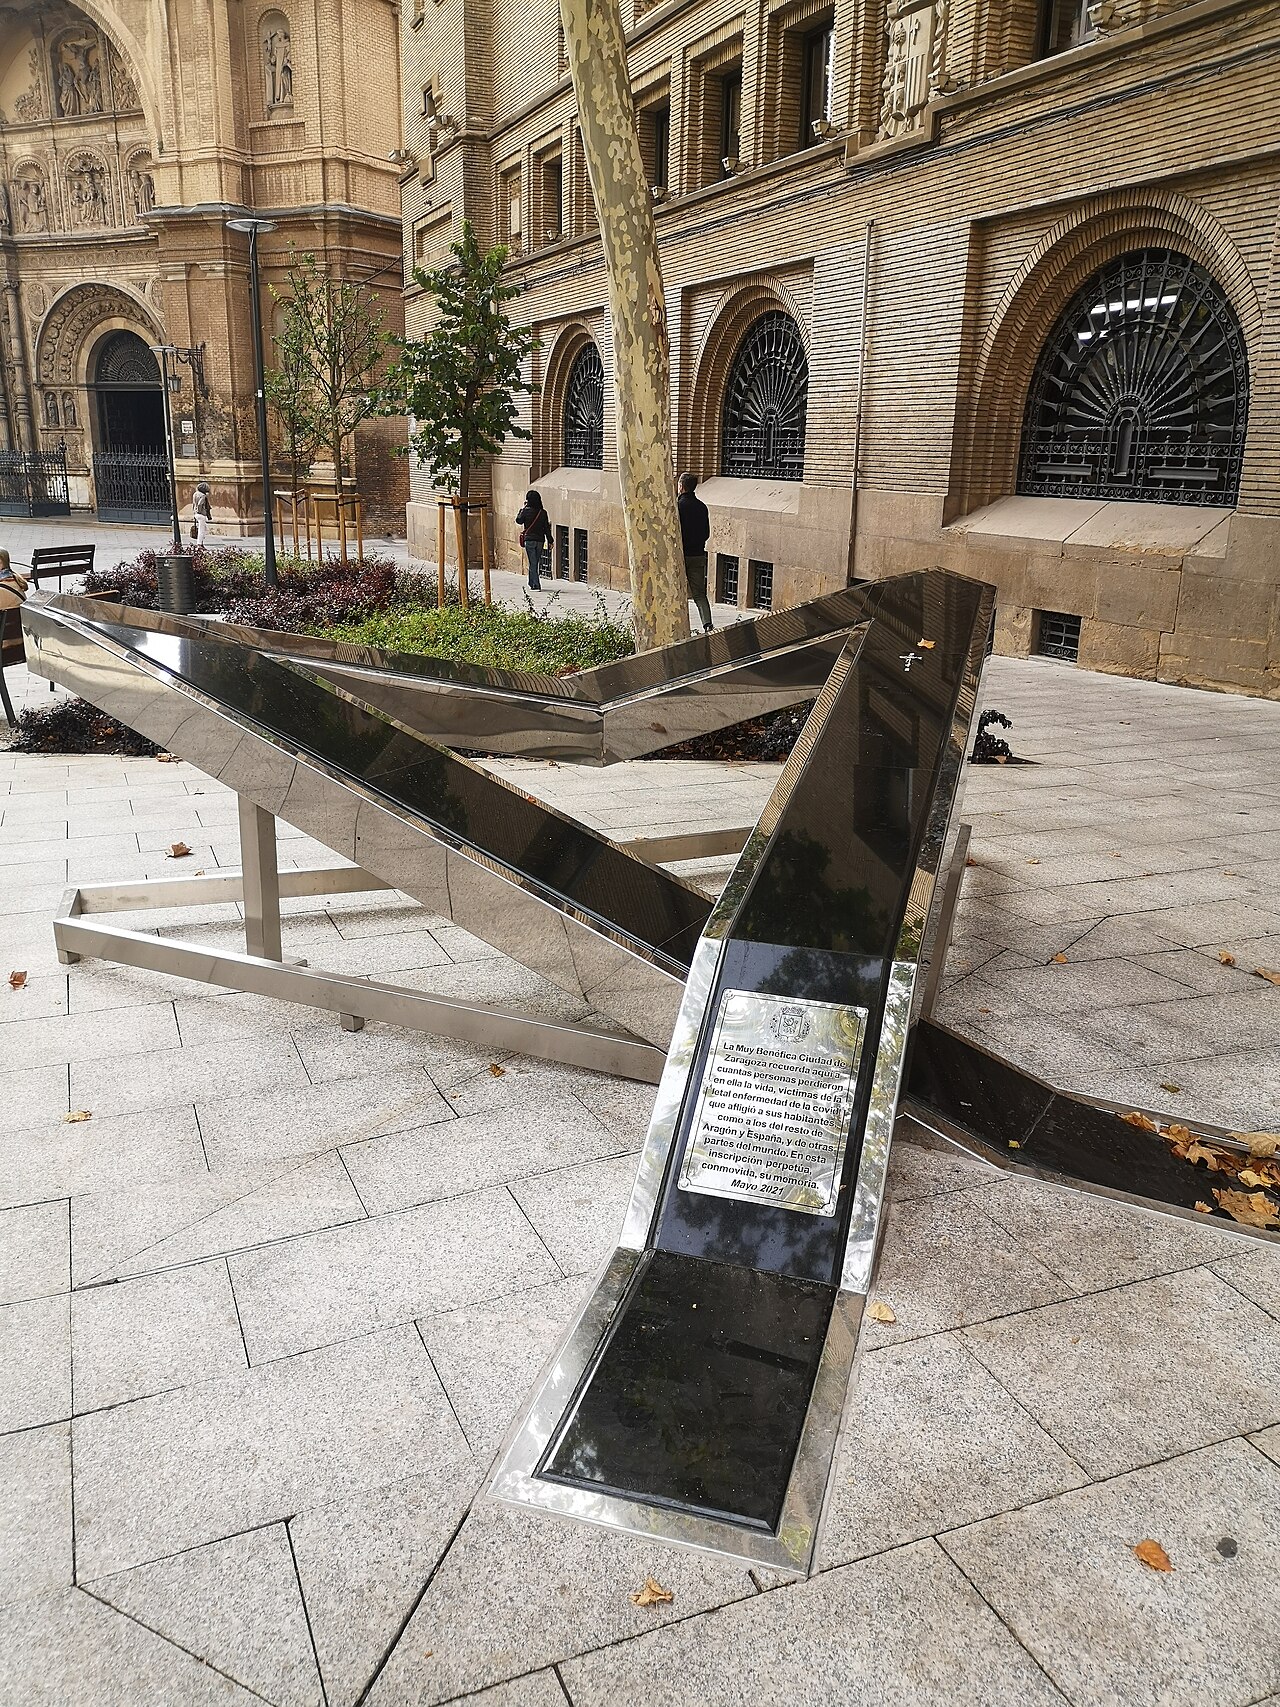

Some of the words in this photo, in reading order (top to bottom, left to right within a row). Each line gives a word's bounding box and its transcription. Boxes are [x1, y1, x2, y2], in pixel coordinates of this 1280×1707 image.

[724, 1042, 734, 1050] La
[736, 1044, 754, 1055] Muy
[756, 1047, 797, 1060] Benéfica
[798, 1054, 832, 1066] Ciudad
[834, 1060, 846, 1068] de
[724, 1054, 766, 1067] Zaragoza
[768, 1062, 810, 1074] recuerda
[716, 1066, 752, 1076] cuantas
[753, 1072, 796, 1084] personas
[798, 1078, 844, 1091] perdieron
[726, 1078, 742, 1088] ella
[744, 1080, 752, 1088] la
[754, 1082, 776, 1094] vida,
[820, 1094, 832, 1102] de
[834, 1095, 842, 1103] la
[708, 1100, 726, 1108] que
[728, 1102, 756, 1114] afligió
[765, 1110, 782, 1118] sus
[711, 1088, 732, 1098] letal
[732, 1092, 788, 1106] enfermedad
[789, 1100, 801, 1108] de
[802, 1102, 810, 1110] la
[702, 1123, 737, 1136] Aragón
[738, 1130, 746, 1138] y
[786, 1138, 792, 1146] y
[794, 1138, 806, 1148] de
[808, 1142, 834, 1152] otras
[717, 1114, 744, 1124] como
[752, 1118, 767, 1128] los
[768, 1122, 784, 1130] del
[784, 1125, 810, 1135] resto
[811, 1128, 824, 1138] de
[704, 1137, 734, 1148] partes
[736, 1142, 752, 1150] del
[752, 1145, 788, 1158] mundo.
[790, 1150, 804, 1160] En
[805, 1154, 826, 1164] esta
[708, 1148, 762, 1166] inscripción
[702, 1162, 758, 1179] conmovida,
[760, 1172, 772, 1180] su
[772, 1174, 819, 1190] memoria.
[730, 1178, 758, 1190] Mayo
[760, 1184, 784, 1196] 2021
